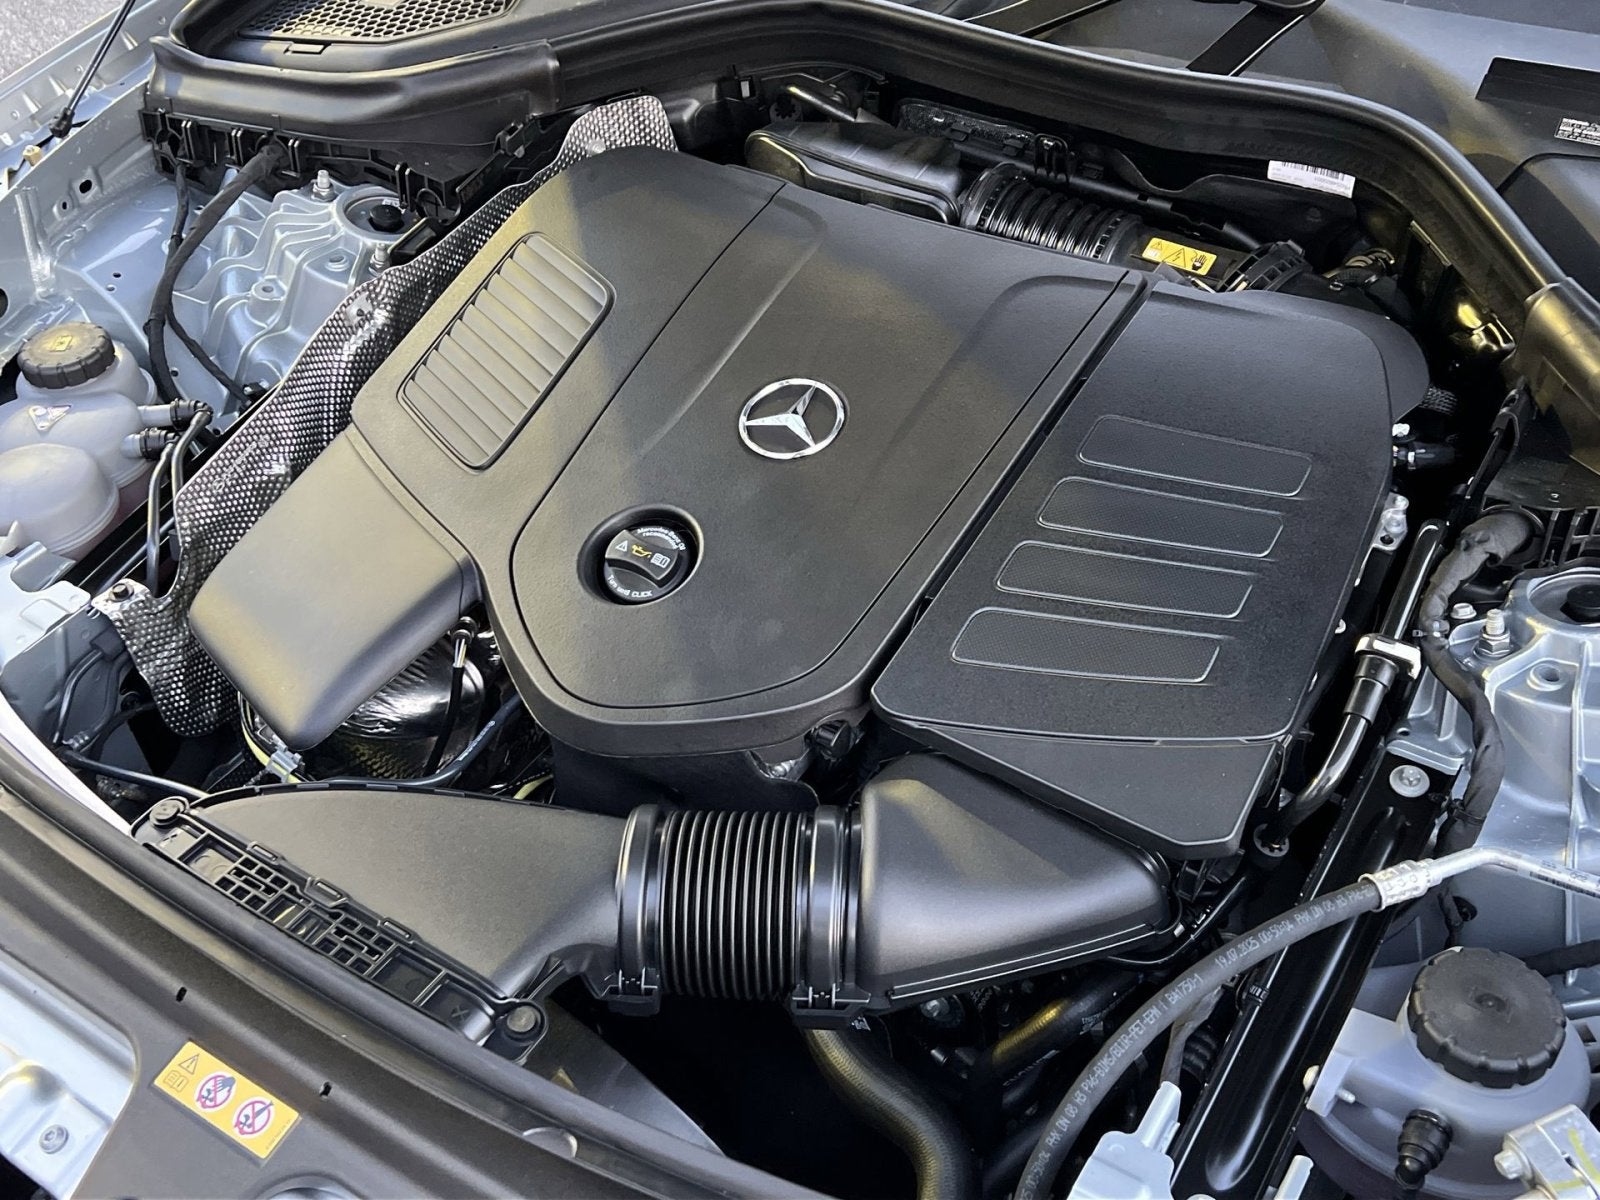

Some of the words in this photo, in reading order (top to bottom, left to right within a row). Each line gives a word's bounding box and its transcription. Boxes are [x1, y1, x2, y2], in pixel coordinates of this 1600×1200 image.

[608, 574, 617, 588] Turn
[616, 586, 631, 596] until
[631, 590, 653, 598] CLICK
[1214, 936, 1260, 969] 19.07.2025
